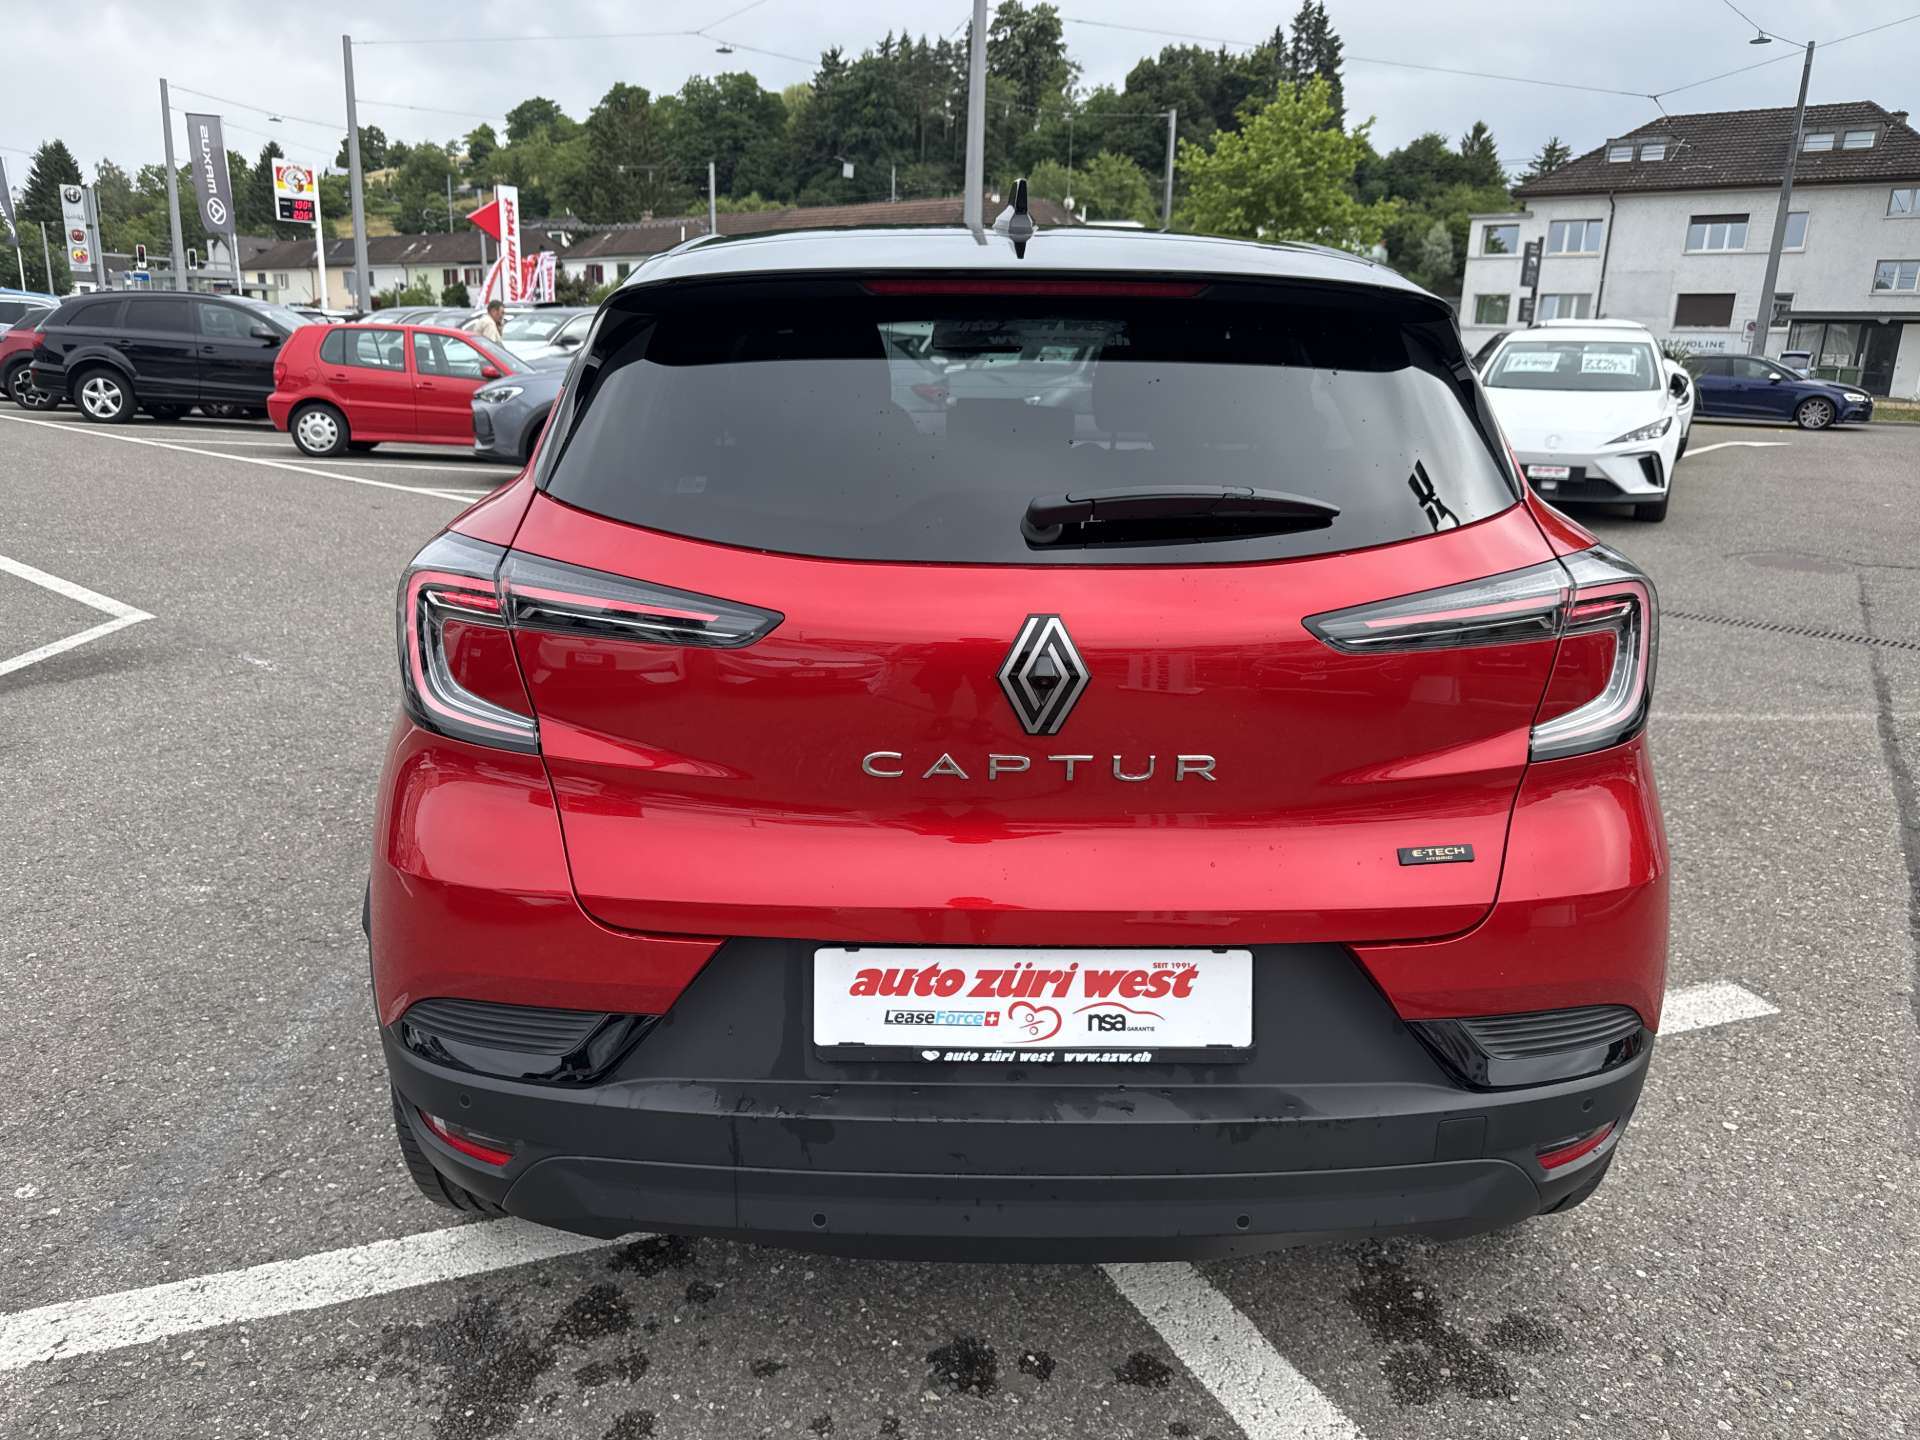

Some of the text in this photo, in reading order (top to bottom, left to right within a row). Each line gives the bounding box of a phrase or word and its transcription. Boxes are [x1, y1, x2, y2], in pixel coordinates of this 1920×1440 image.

[862, 751, 1217, 782] CAPTUR
[1412, 846, 1465, 857] E-TECH
[849, 962, 1200, 998] auto züri west
[884, 1009, 984, 1025] LeaseForce
[1088, 1013, 1126, 1032] nsa
[944, 1050, 1153, 1064] auto züri west www.azw.ch
